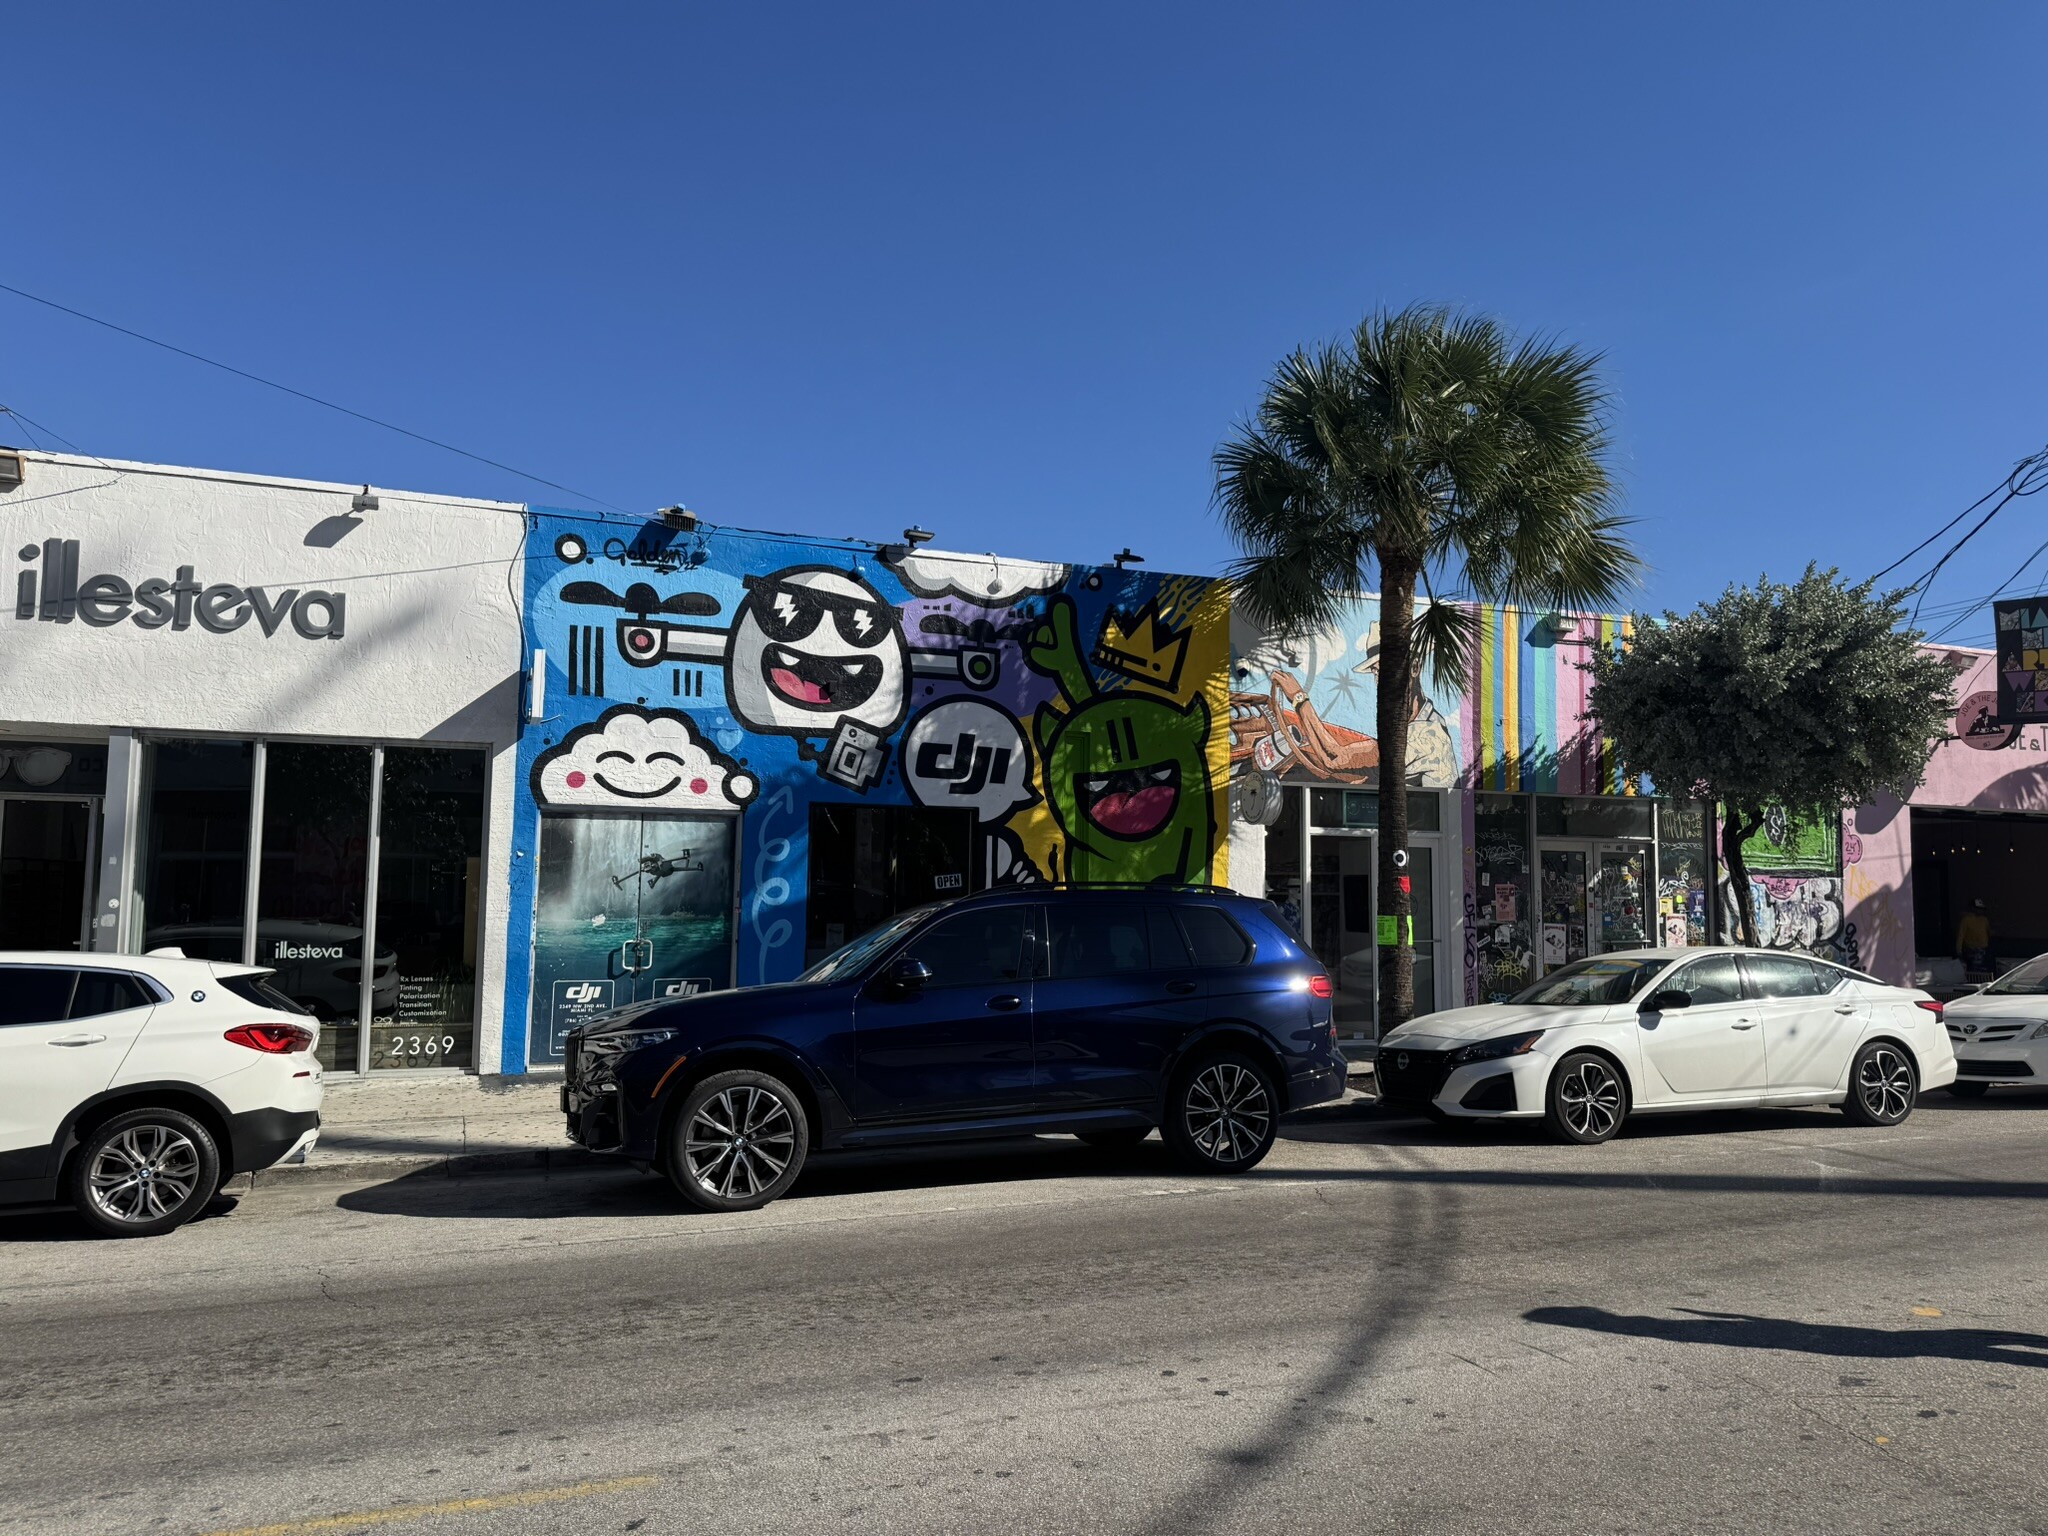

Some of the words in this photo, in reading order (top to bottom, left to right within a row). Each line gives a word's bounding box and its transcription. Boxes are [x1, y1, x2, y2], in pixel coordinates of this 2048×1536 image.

[15, 537, 346, 640] illesteva
[1961, 704, 1973, 717] JOE
[1978, 694, 1991, 703] THE
[2030, 738, 2041, 751] &
[936, 874, 961, 889] OPEN
[275, 941, 343, 960] illesteva
[392, 1036, 455, 1055] 2369
